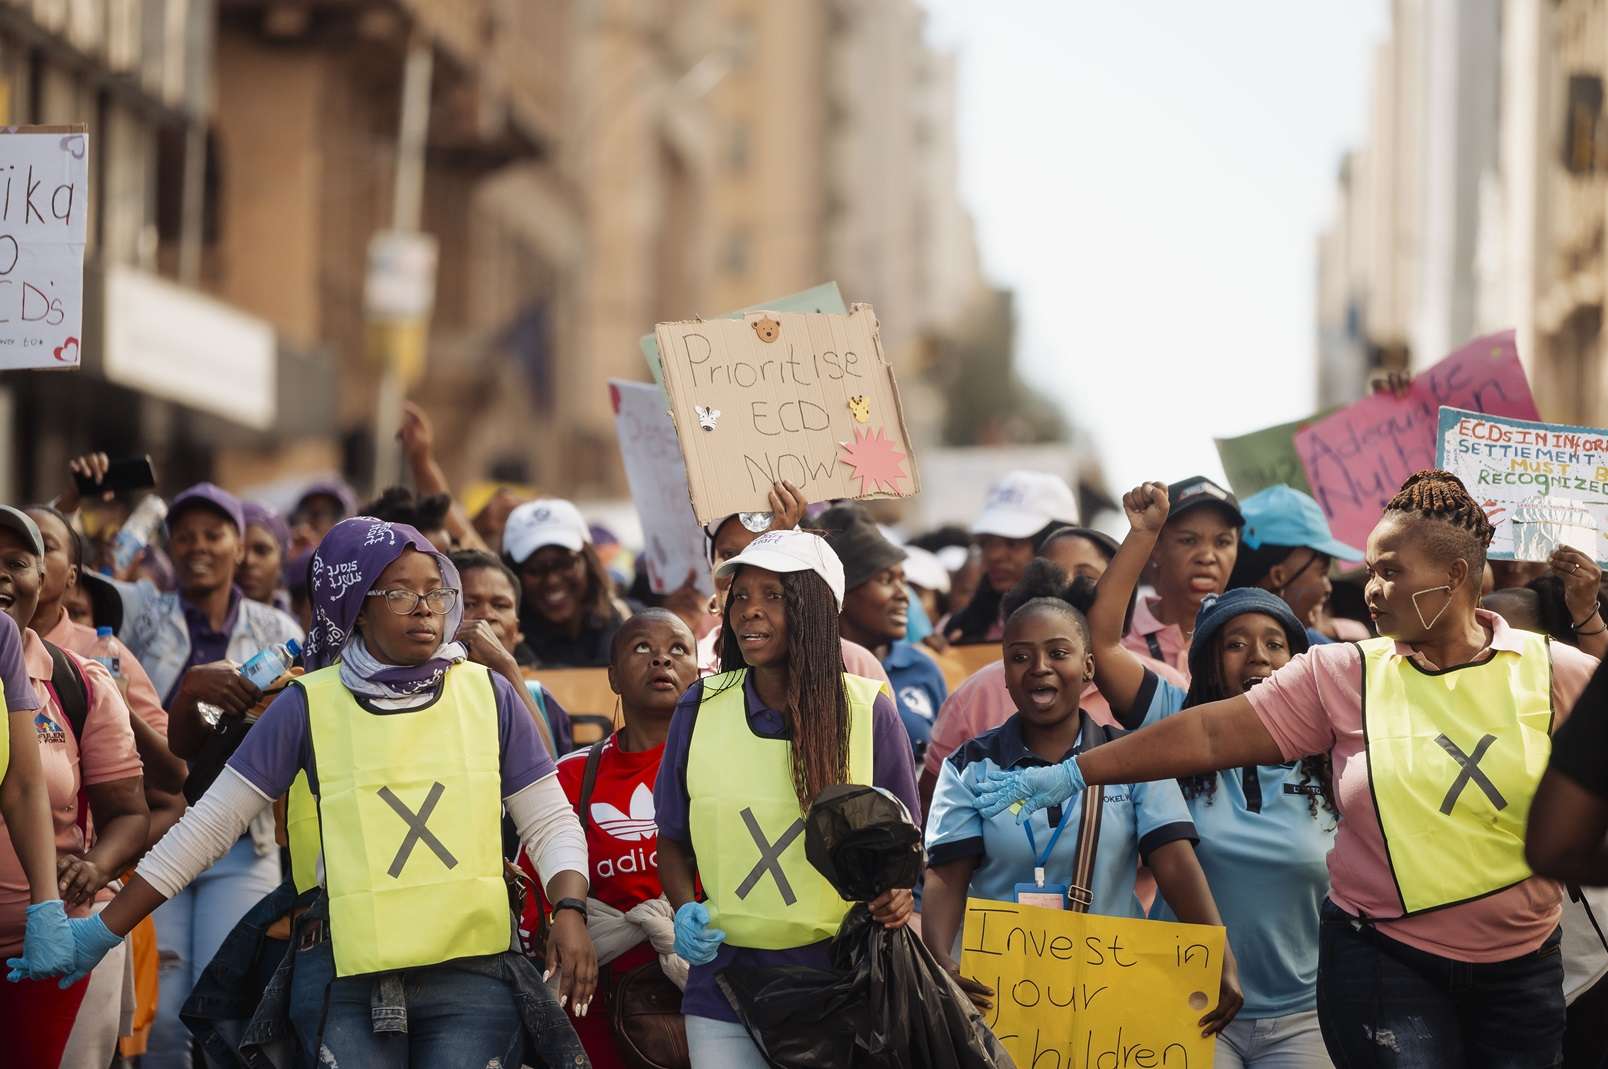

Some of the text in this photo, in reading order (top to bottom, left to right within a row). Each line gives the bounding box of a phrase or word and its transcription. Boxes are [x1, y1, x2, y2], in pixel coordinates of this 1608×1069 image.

[0, 164, 74, 226] ika
[682, 333, 863, 388] Prioritise
[752, 400, 830, 436] ECD
[1514, 431, 1548, 448] IN
[744, 452, 838, 494] NOW
[1510, 457, 1570, 476] MUST
[964, 908, 1209, 969] Invest in
[998, 1027, 1188, 1069] hildren
